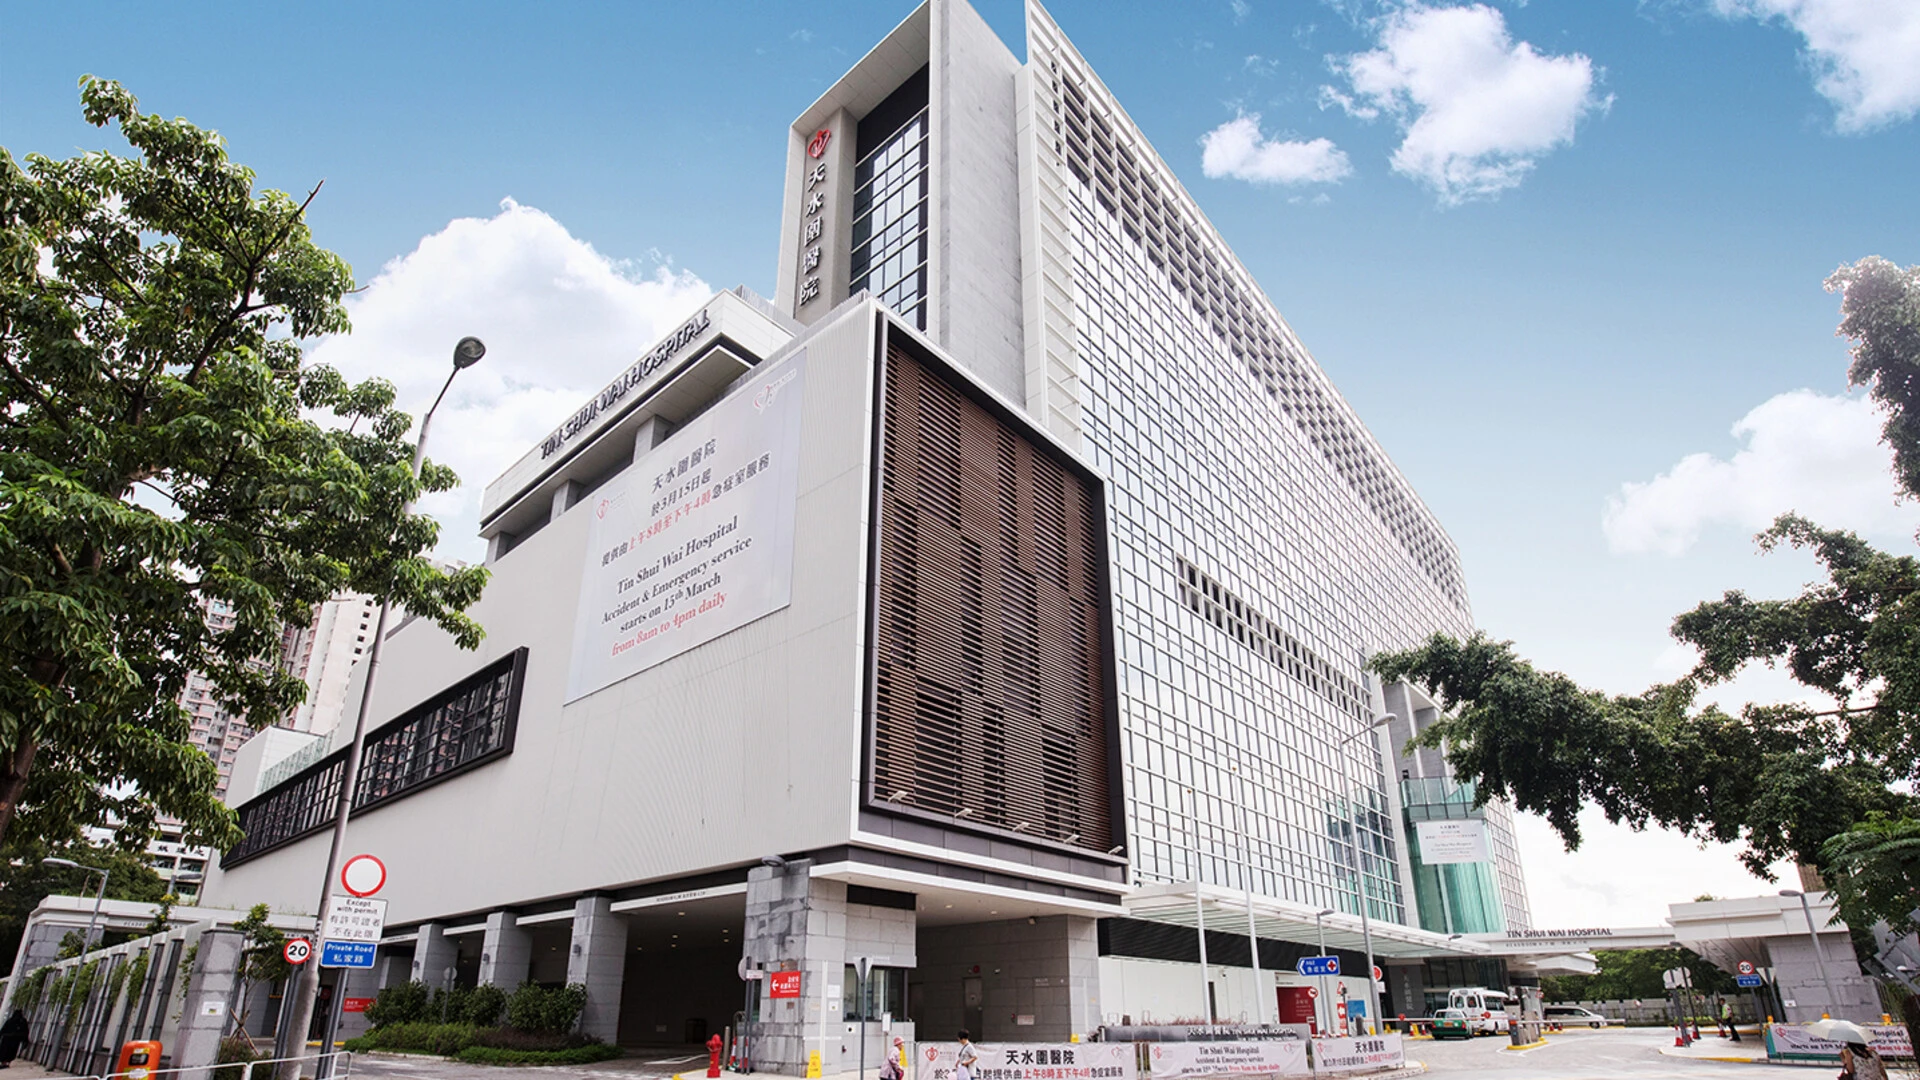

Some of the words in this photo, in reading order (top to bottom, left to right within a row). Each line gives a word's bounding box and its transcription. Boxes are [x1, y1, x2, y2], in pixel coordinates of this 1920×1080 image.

[799, 162, 827, 307] 天水圍醫院
[540, 429, 564, 460] TIN
[564, 400, 599, 441] SHUI
[600, 374, 631, 412] WAI
[630, 309, 711, 388] HOSPITAL
[617, 578, 635, 594] Tin
[636, 560, 660, 583] Shui
[662, 547, 683, 569] Wai
[685, 515, 738, 557] Hospital
[601, 598, 641, 624] Accident
[642, 590, 650, 603] &
[651, 561, 709, 598] Emergency
[711, 537, 752, 567] service
[620, 612, 647, 633] starts
[648, 605, 661, 618] on
[663, 590, 683, 611] 15th
[685, 572, 721, 600] March
[611, 638, 635, 656] from
[636, 627, 658, 644] 8am
[660, 621, 671, 633] to
[673, 607, 696, 629] 4pm
[698, 591, 727, 614] daily
[346, 899, 371, 907] Except
[288, 945, 308, 956] 20
[326, 943, 352, 952] Private
[354, 945, 374, 953] Road
[1506, 930, 1521, 938] TIN
[1523, 929, 1546, 938] SHUI
[1548, 929, 1565, 937] WAI
[1568, 928, 1612, 937] HOSPITAL
[1006, 1050, 1075, 1065] 天水圍醫院
[1199, 1046, 1209, 1054] Tin
[1210, 1046, 1223, 1054] Shui
[1224, 1046, 1235, 1054] Wai
[1236, 1046, 1260, 1055] Hospital
